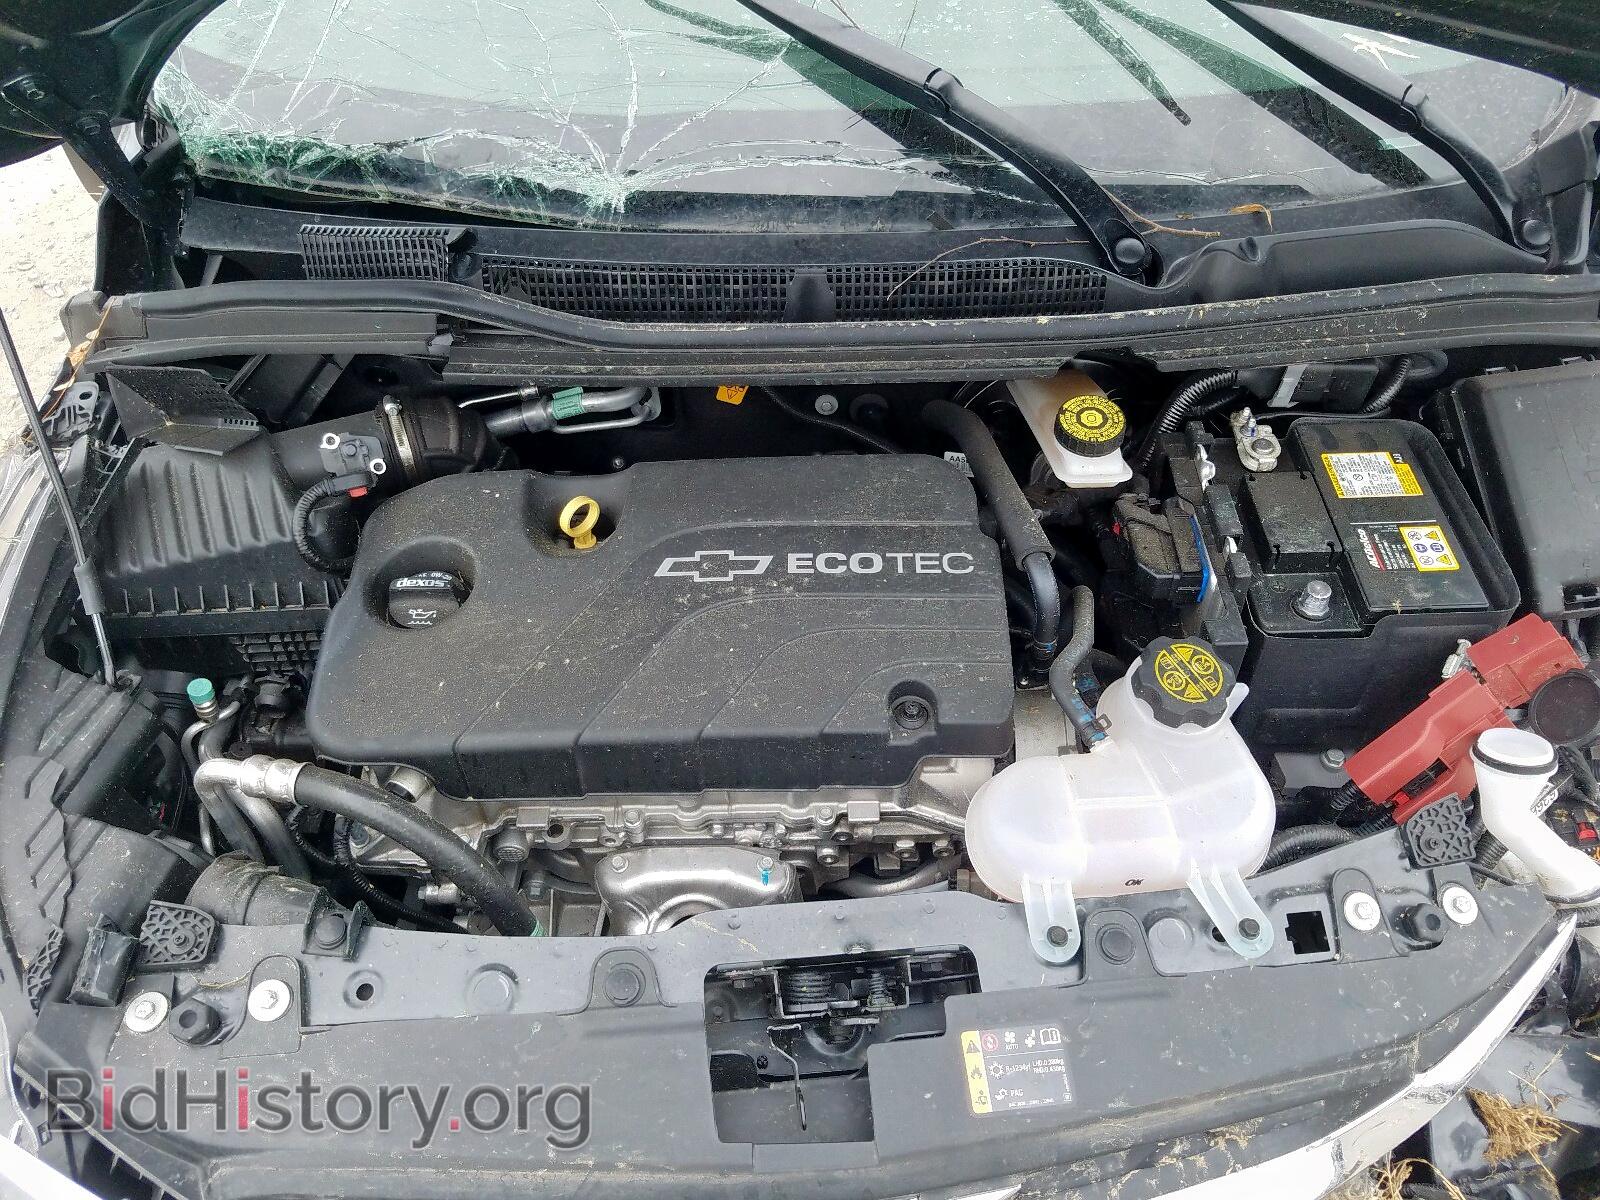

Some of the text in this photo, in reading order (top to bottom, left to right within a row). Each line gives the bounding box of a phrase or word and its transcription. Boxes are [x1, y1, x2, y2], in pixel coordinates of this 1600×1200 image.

[1358, 528, 1381, 569] ACDelco
[787, 552, 975, 575] ECOTEC
[396, 578, 449, 587] dexos
[1010, 1088, 1024, 1097] PAG
